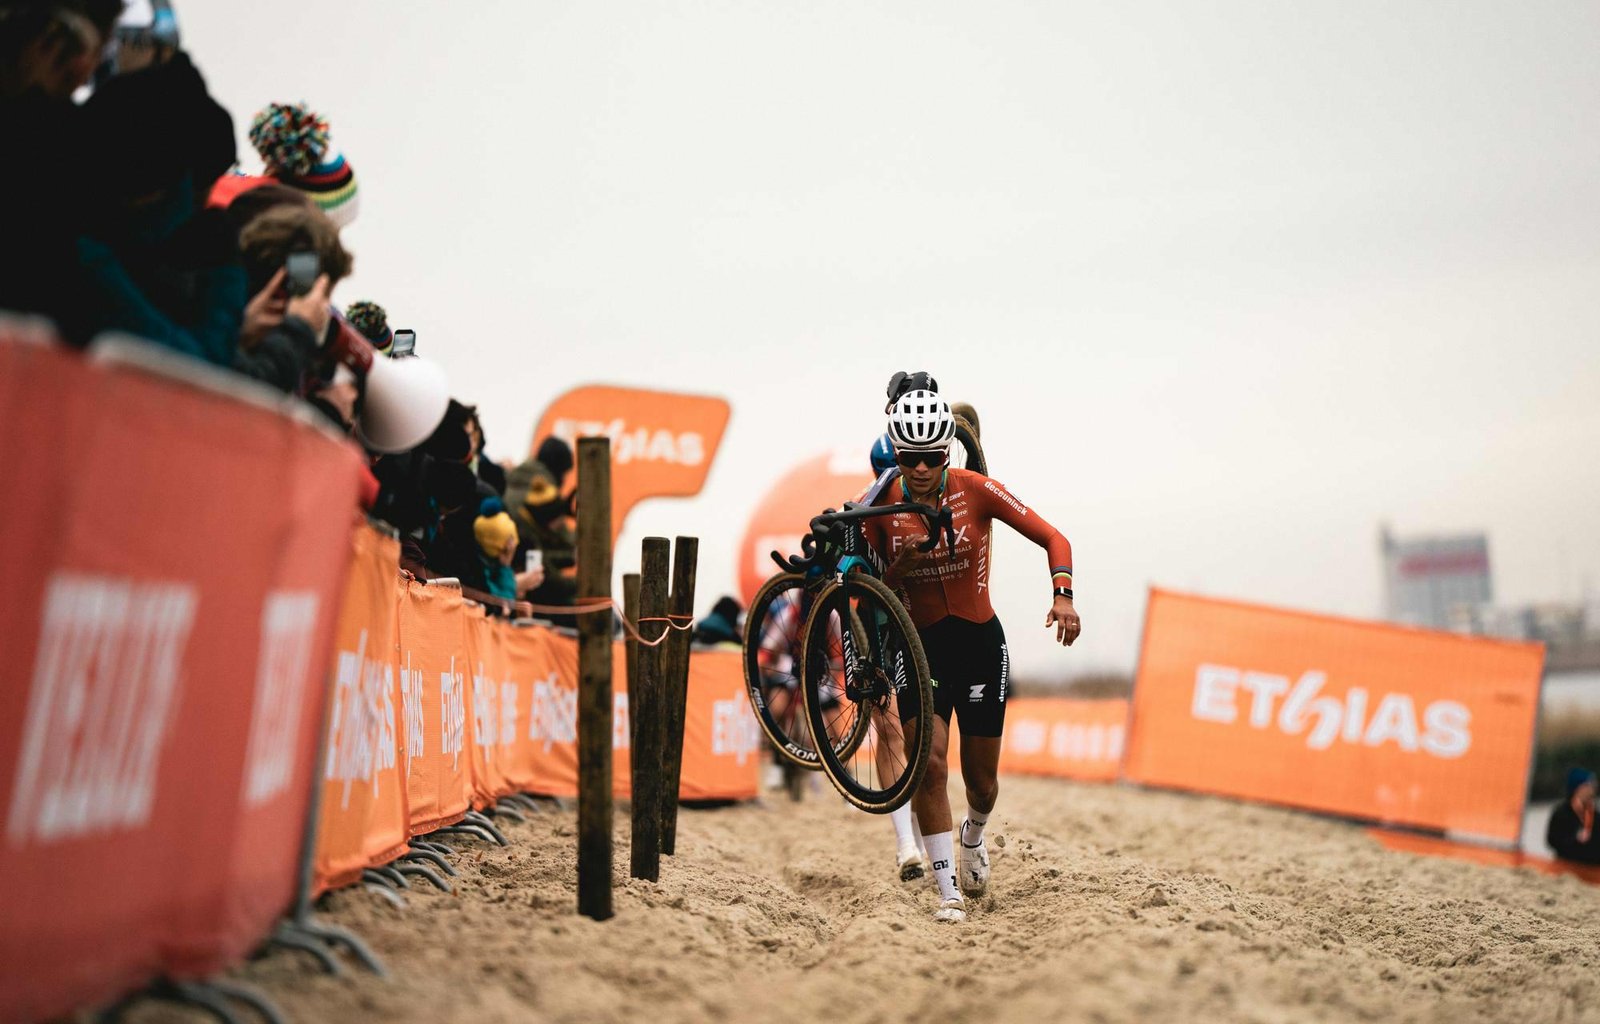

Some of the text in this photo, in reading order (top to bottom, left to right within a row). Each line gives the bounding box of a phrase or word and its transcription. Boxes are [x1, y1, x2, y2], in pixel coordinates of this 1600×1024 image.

[984, 481, 1028, 516] deceuninck
[935, 545, 973, 558] MATRIALS
[977, 533, 988, 595] FENIX
[999, 643, 1008, 702] deceuninck
